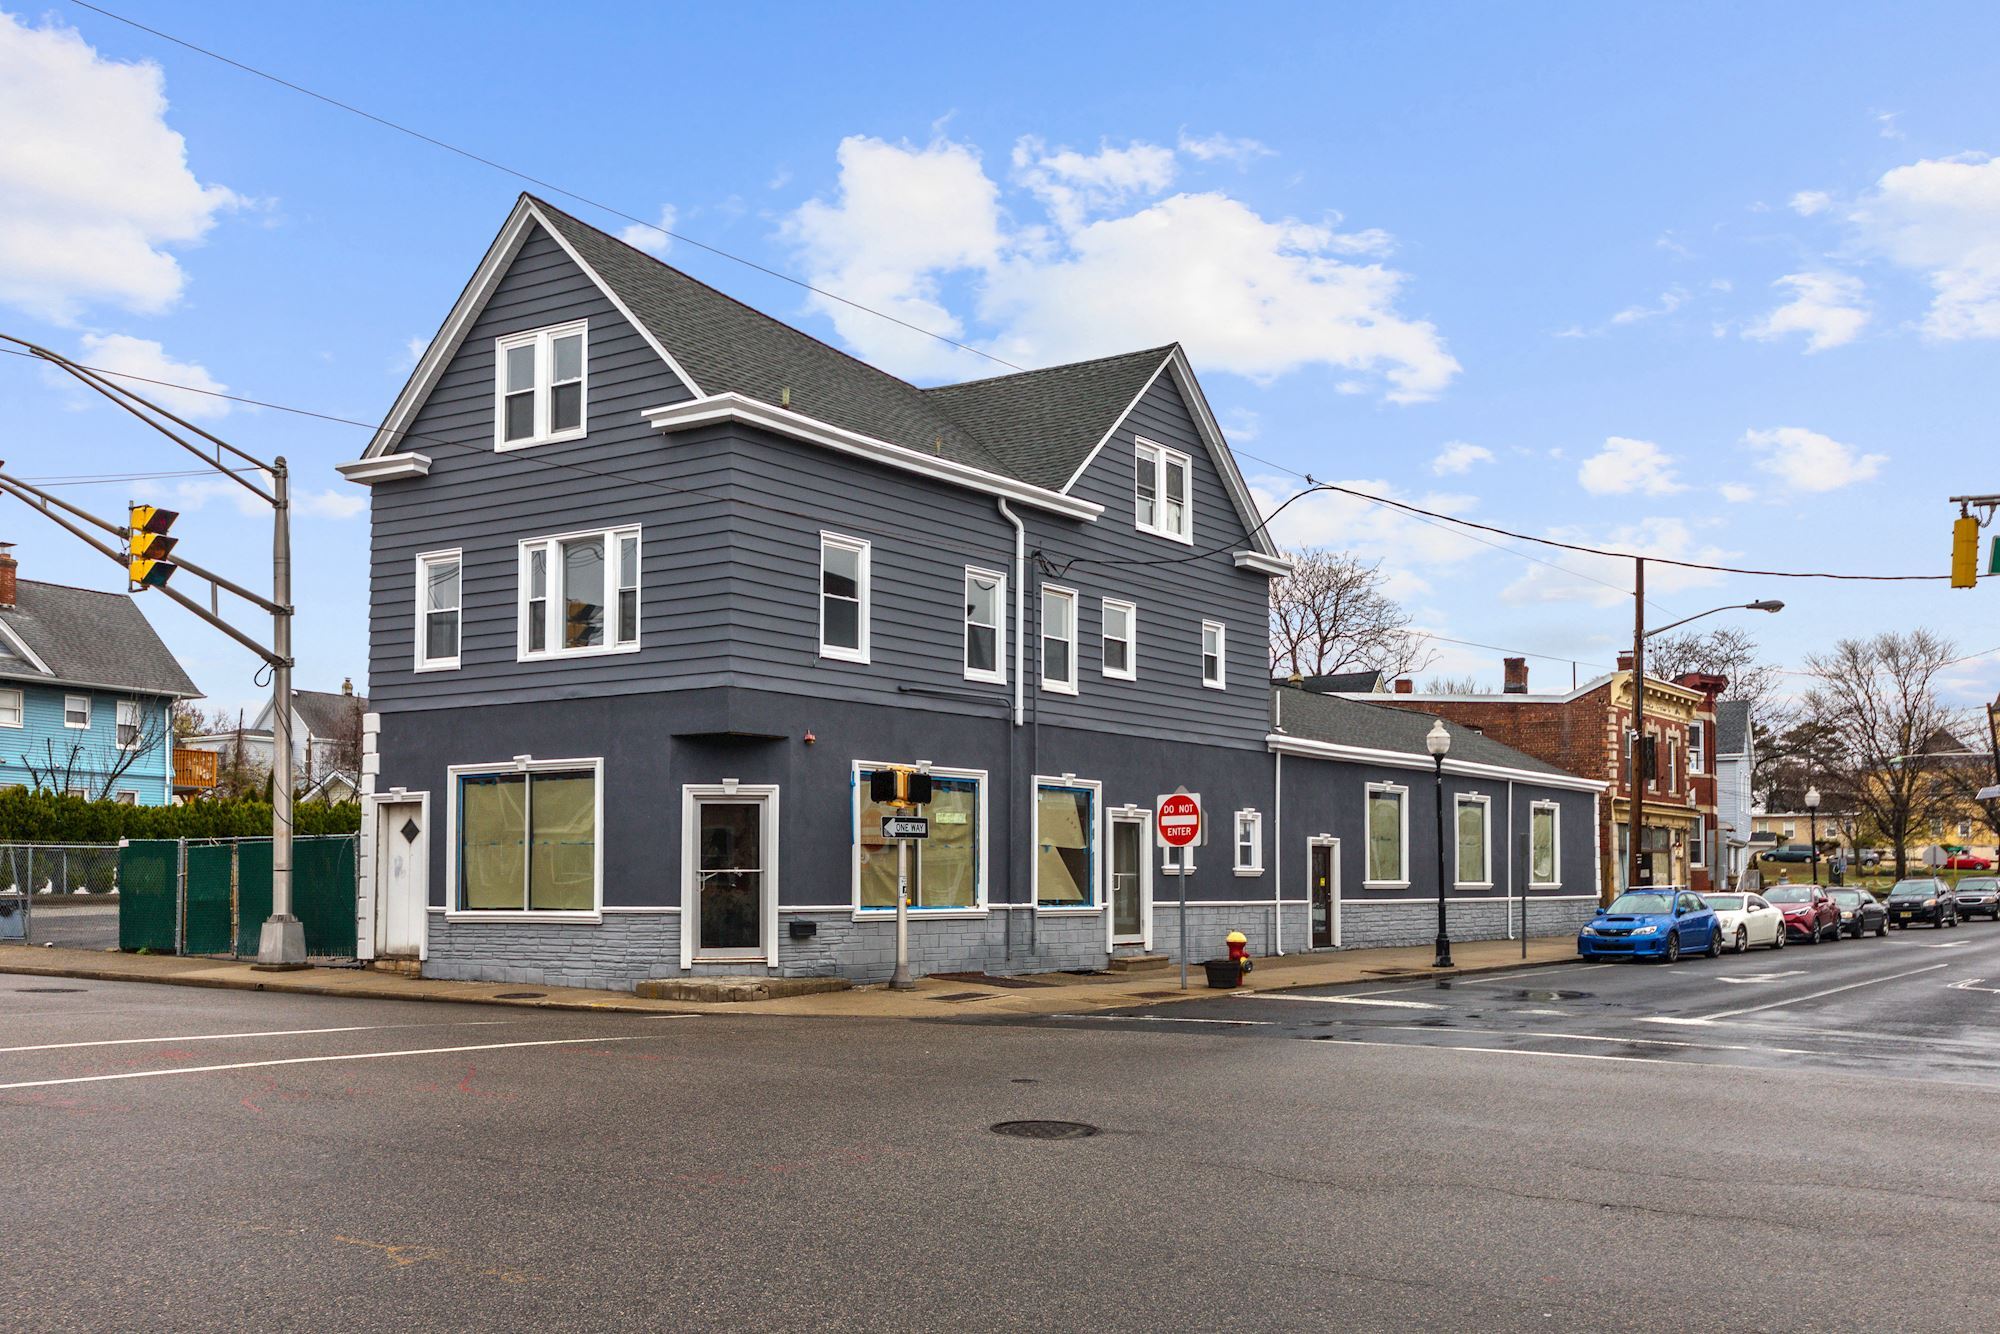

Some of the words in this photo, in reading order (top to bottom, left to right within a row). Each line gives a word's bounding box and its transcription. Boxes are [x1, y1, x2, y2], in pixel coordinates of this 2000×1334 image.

[1163, 805, 1174, 814] DO
[1179, 804, 1193, 813] NOT
[896, 823, 909, 832] ONE
[911, 824, 924, 832] WAY
[1167, 827, 1191, 836] ENTER
